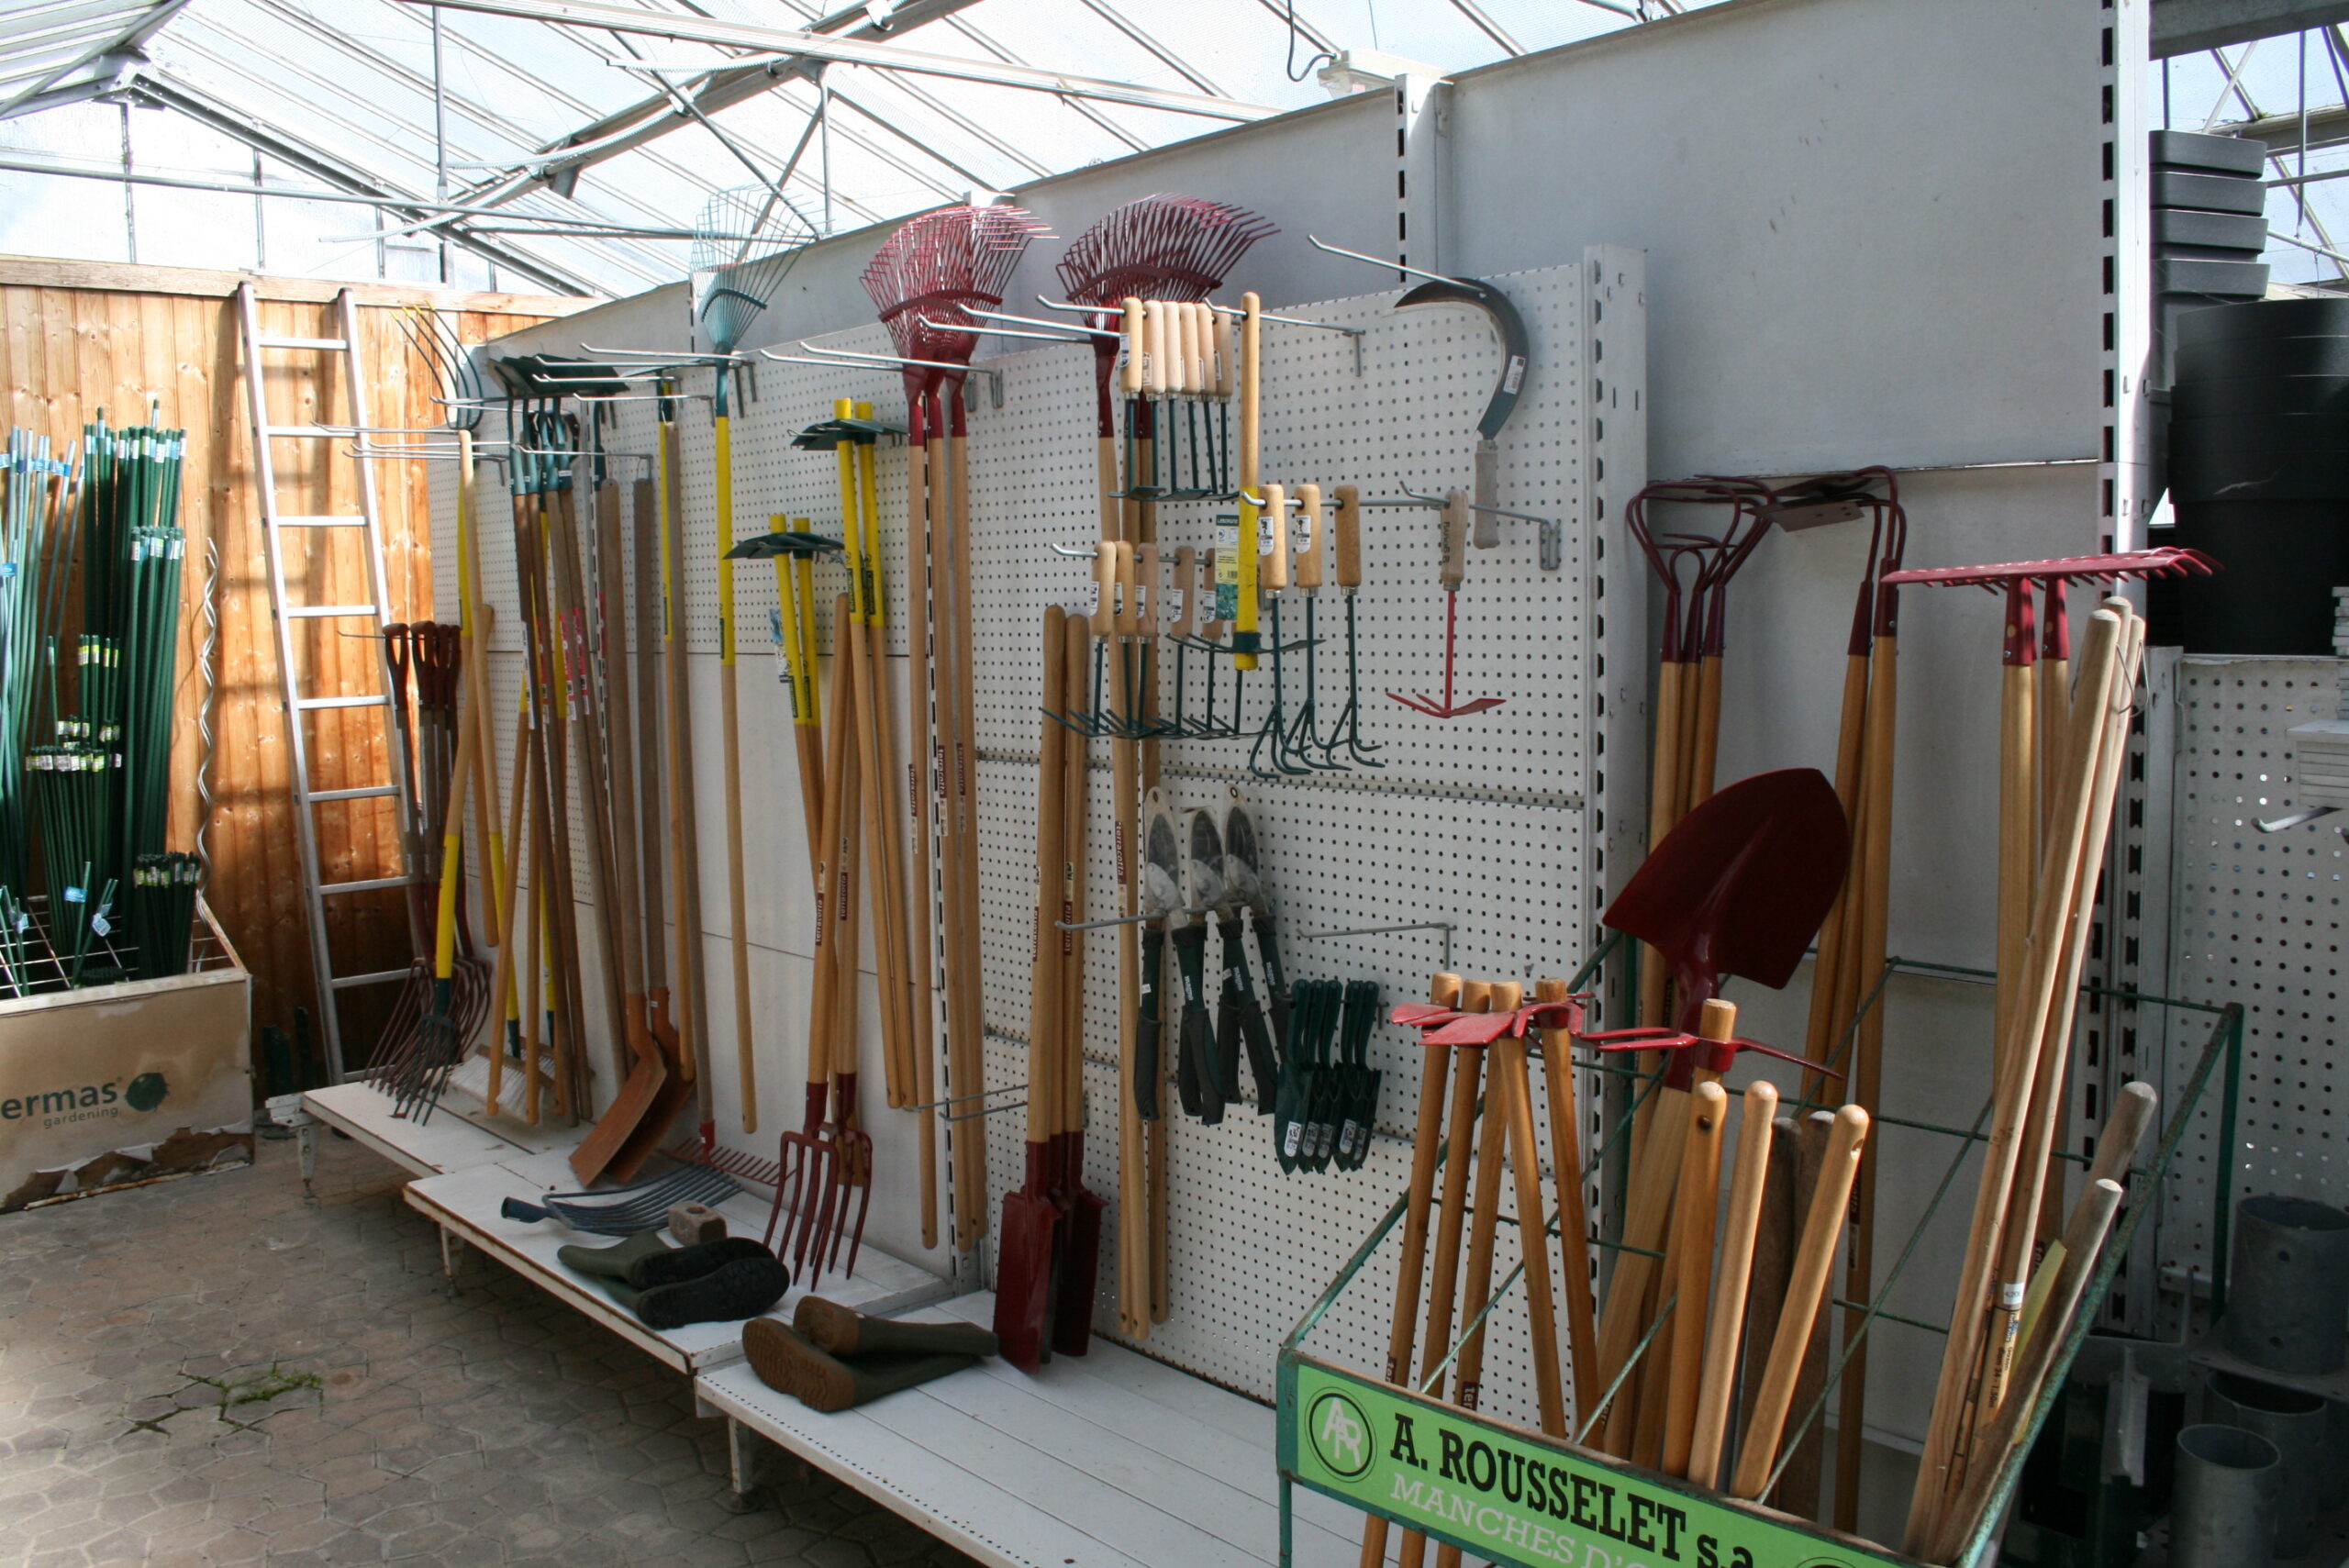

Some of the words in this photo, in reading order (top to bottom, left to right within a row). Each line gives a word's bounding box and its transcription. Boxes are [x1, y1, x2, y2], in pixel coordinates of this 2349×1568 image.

[1116, 824, 1124, 876] terracotta
[1063, 905, 1072, 951] terraotta
[43, 1106, 119, 1129] gardening
[1390, 1412, 1428, 1471] A.
[1439, 1428, 1687, 1562] ROUSSELET
[1390, 1473, 1575, 1563] MANCHES
